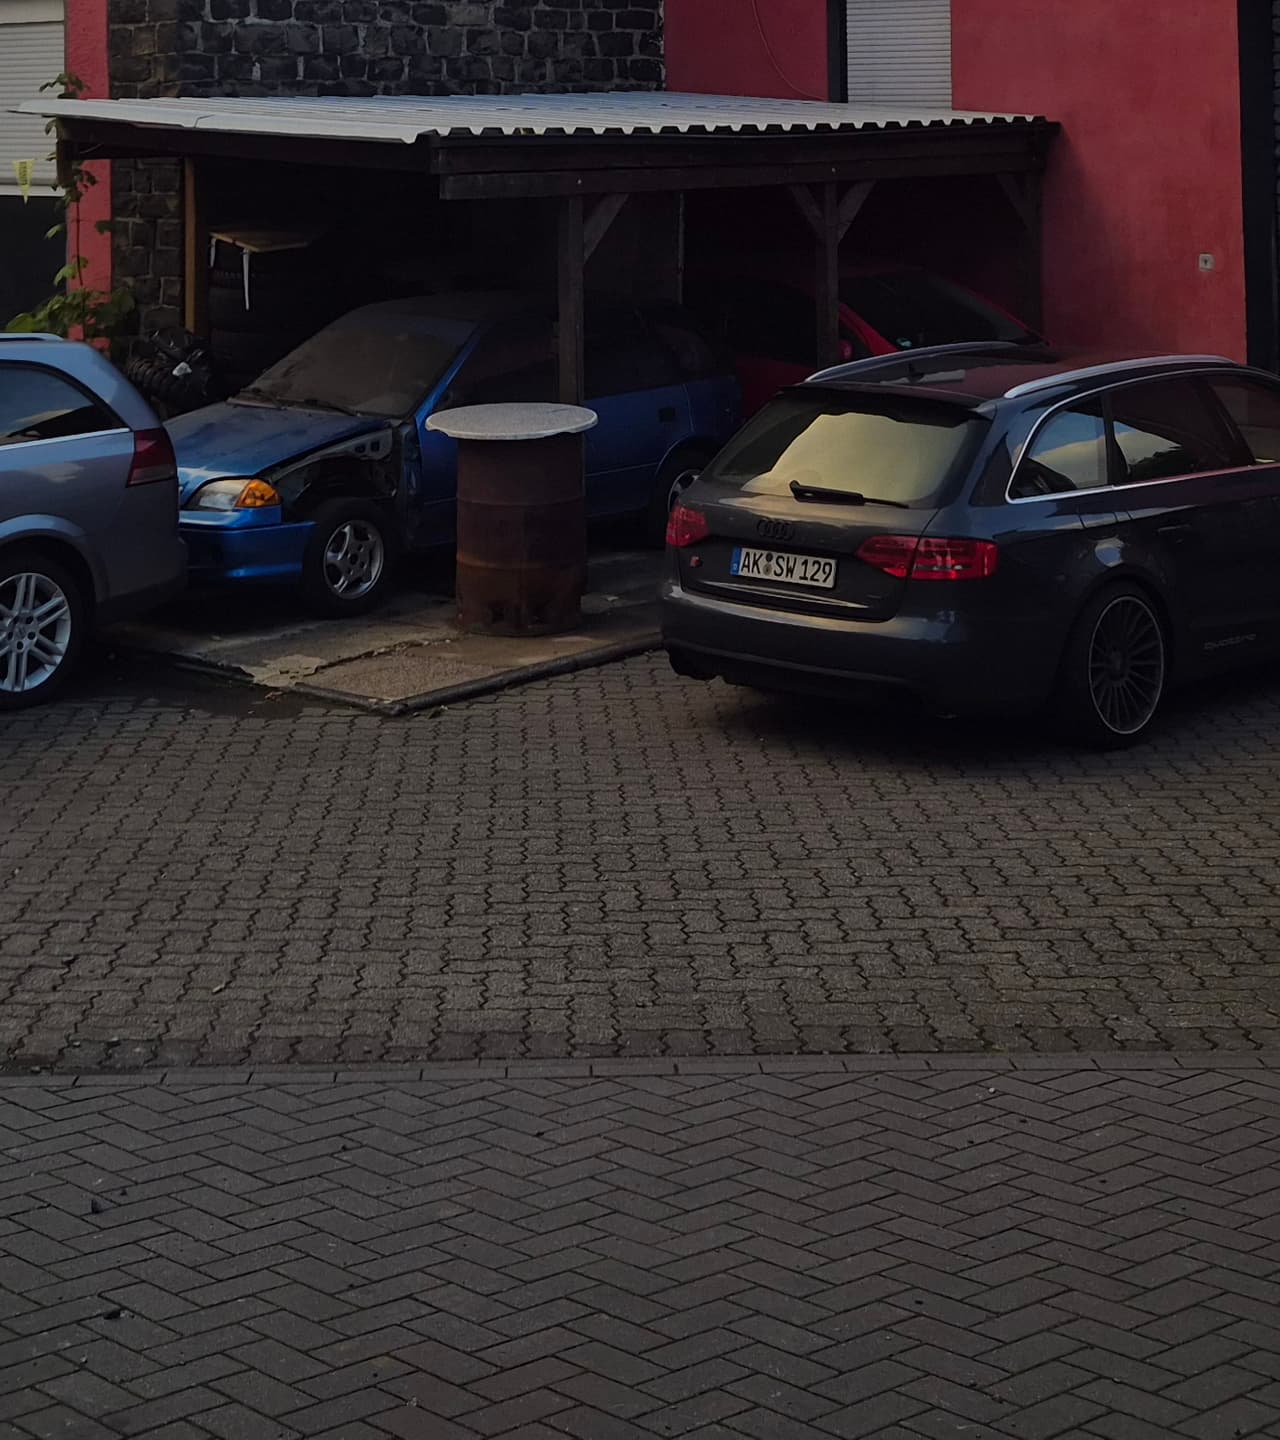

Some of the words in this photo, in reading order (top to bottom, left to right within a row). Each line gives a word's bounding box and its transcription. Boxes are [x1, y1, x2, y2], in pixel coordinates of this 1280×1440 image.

[741, 551, 763, 575] AK
[773, 555, 797, 579] SW
[798, 559, 833, 584] 129
